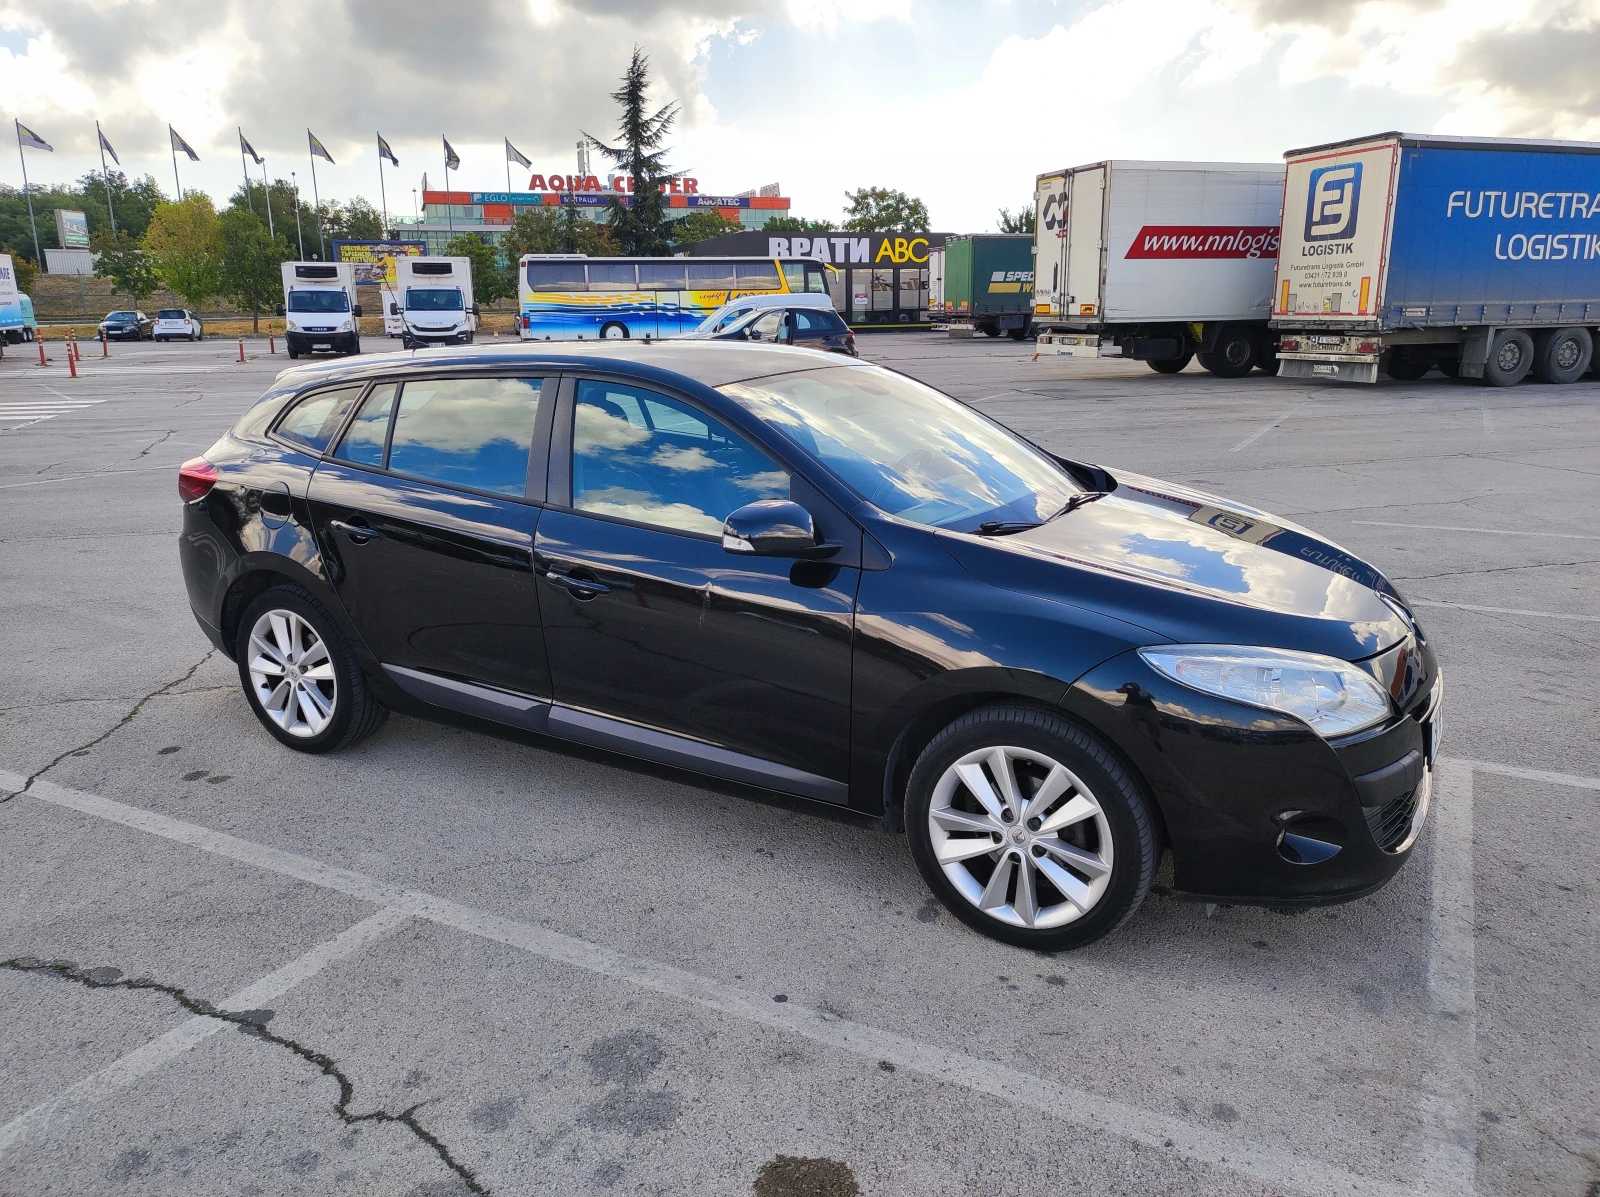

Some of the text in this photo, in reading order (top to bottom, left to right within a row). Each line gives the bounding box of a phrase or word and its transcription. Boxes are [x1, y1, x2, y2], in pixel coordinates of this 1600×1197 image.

[529, 174, 603, 191] AQUA
[484, 194, 508, 202] EGLO
[563, 196, 598, 204] МТРАЦИ
[768, 237, 870, 263] ВРАТИ
[1302, 242, 1354, 257] LOGISTIK
[1290, 260, 1365, 271] Futuretrans Logistik GmbH
[699, 292, 726, 302] voyages
